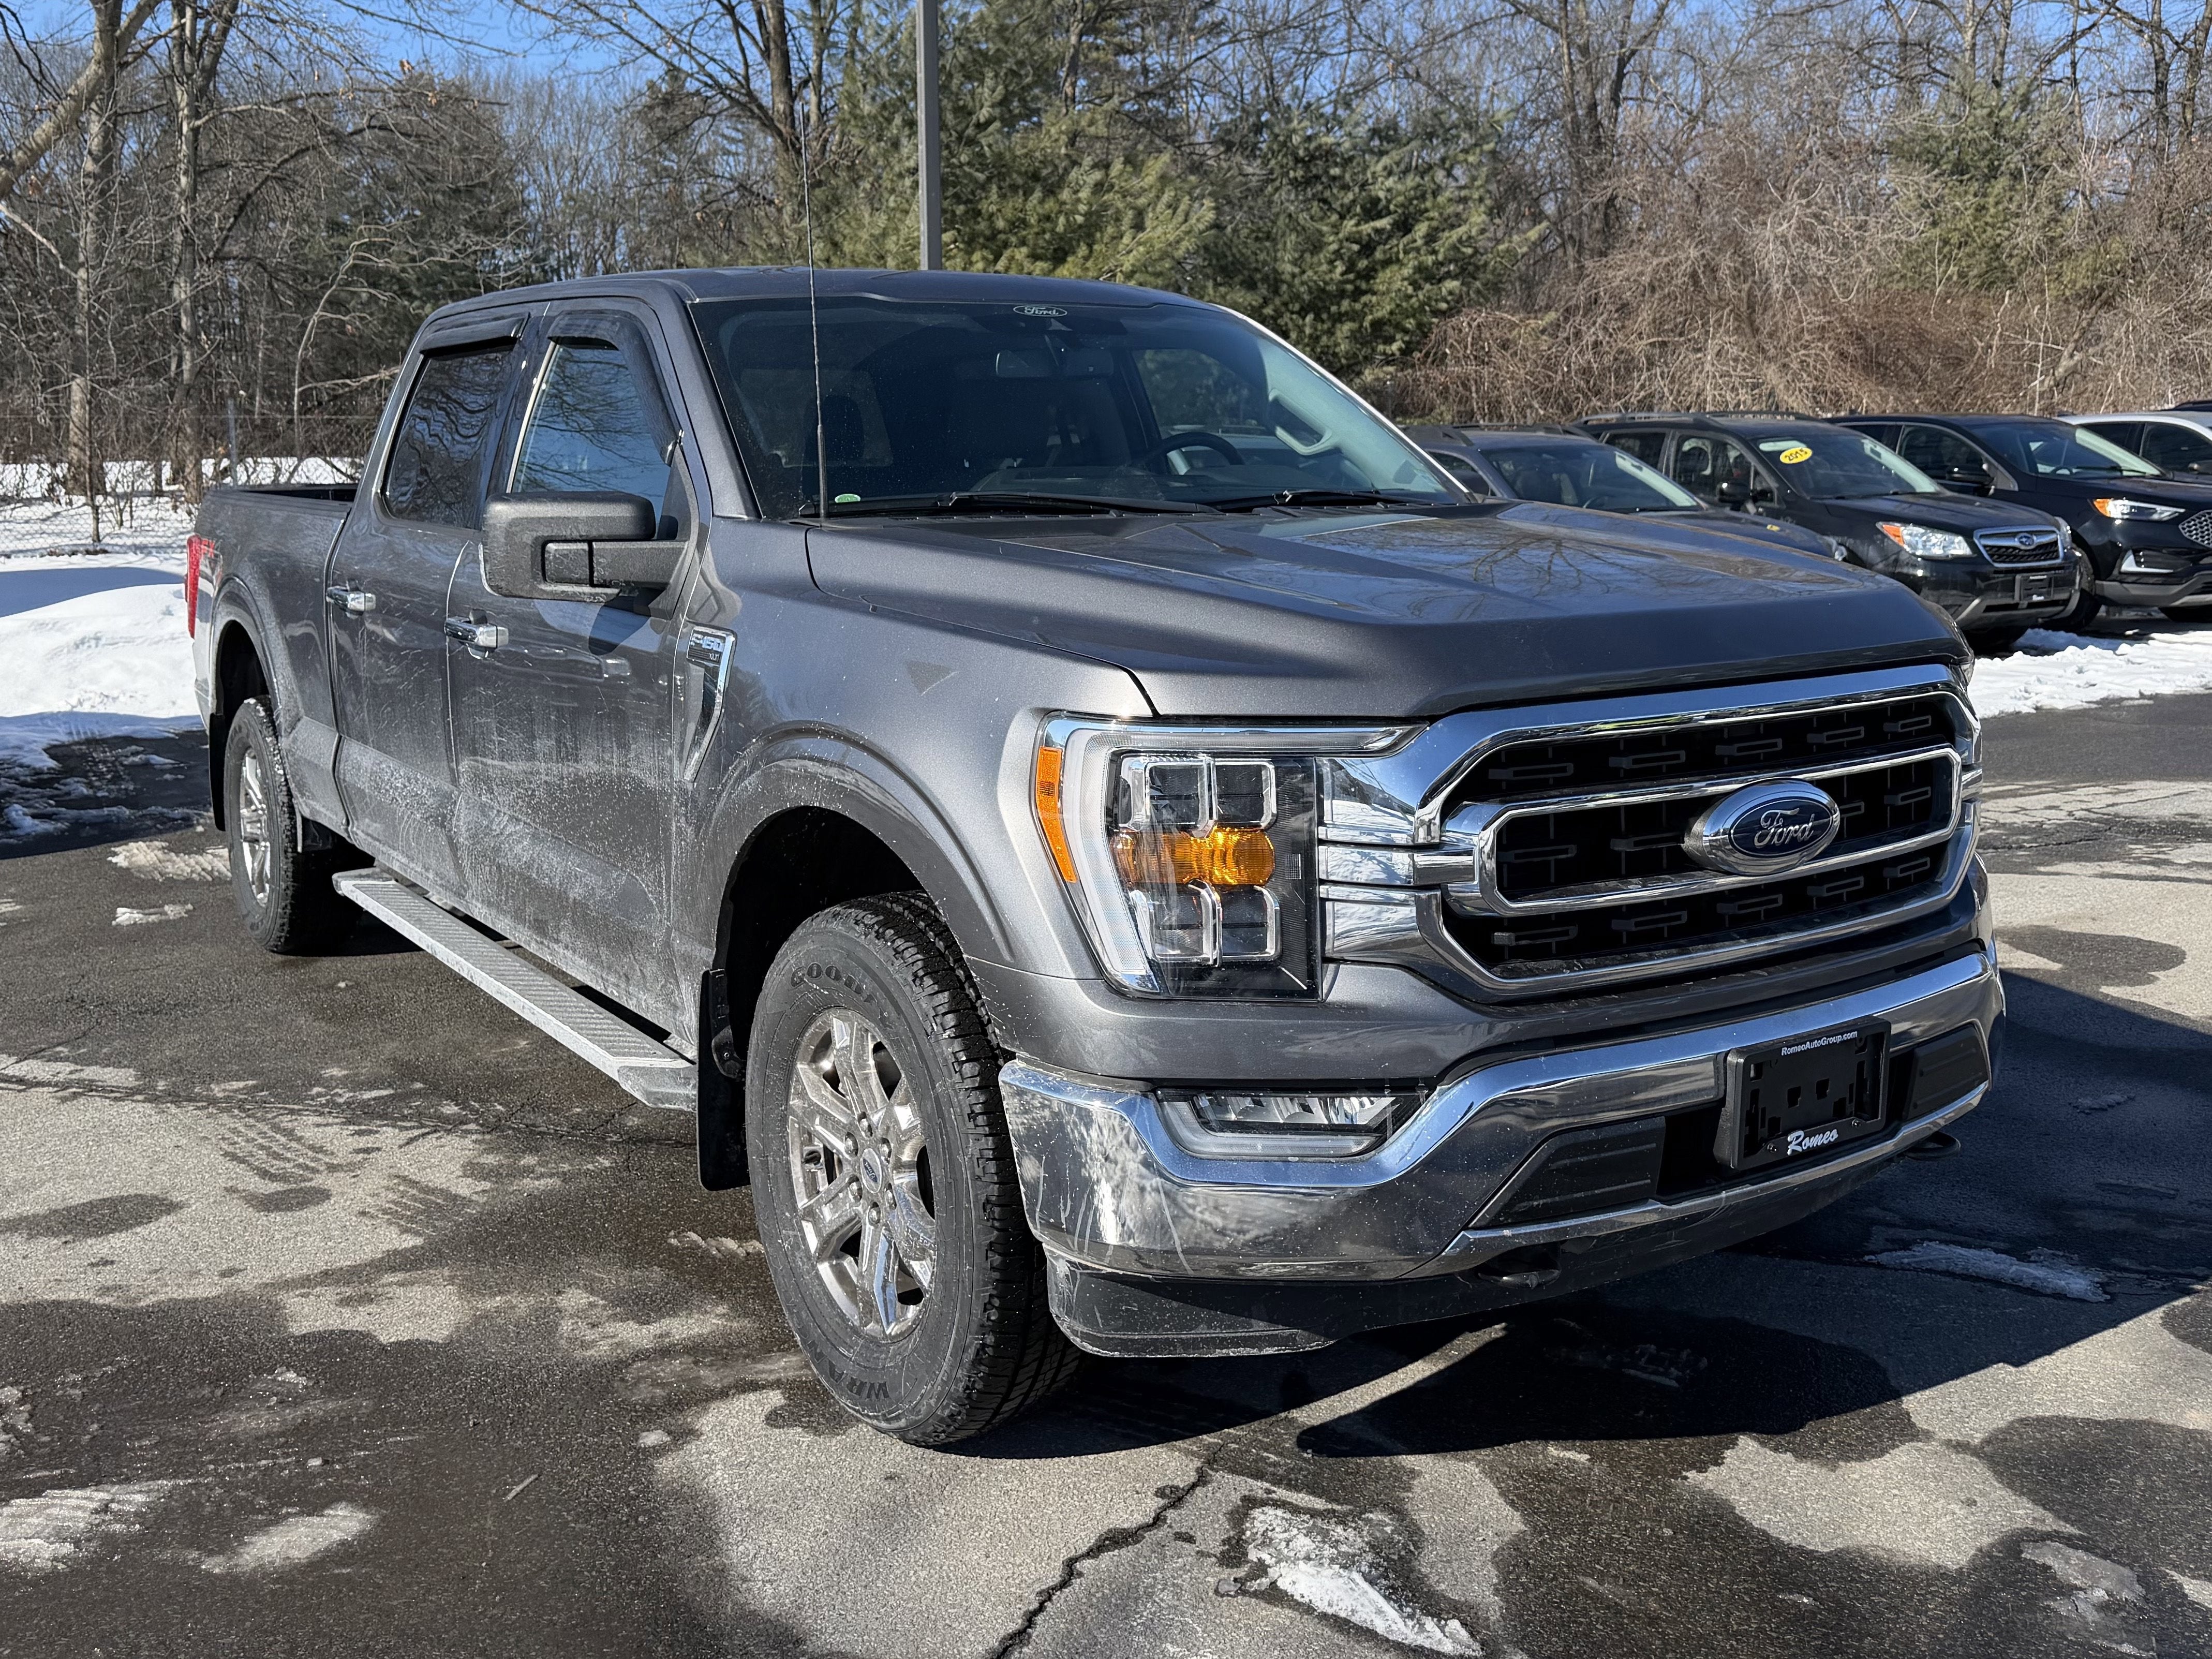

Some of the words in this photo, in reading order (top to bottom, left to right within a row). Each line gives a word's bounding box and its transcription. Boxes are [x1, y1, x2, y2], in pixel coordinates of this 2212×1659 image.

[1025, 306, 1059, 316] Ford
[1785, 448, 1808, 462] 2015
[1754, 807, 1816, 849] Ford
[1781, 1030, 1858, 1056] RomeoAutoGroup.com
[1787, 1129, 1838, 1157] Romeo
